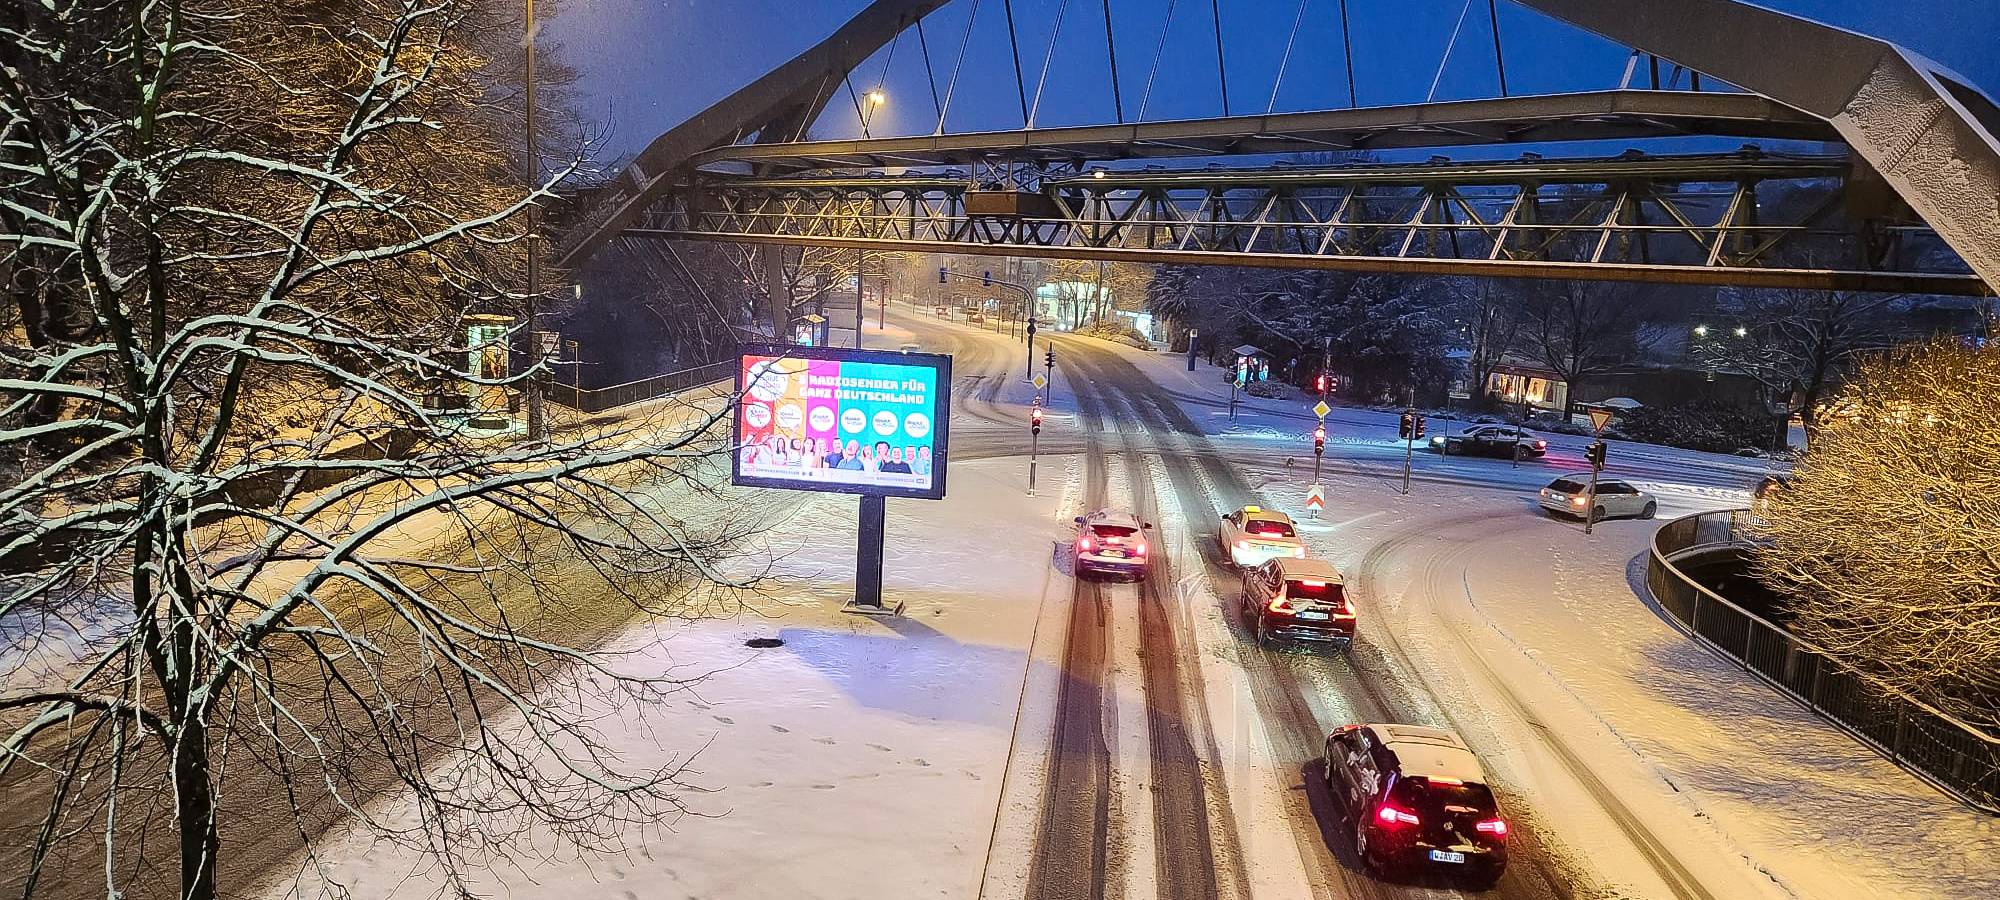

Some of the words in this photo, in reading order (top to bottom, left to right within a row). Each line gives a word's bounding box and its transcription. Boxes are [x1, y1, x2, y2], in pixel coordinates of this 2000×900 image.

[901, 379, 926, 392] FÜR
[799, 387, 832, 398] GANZ
[834, 389, 924, 404] DEUTSCHLAND
